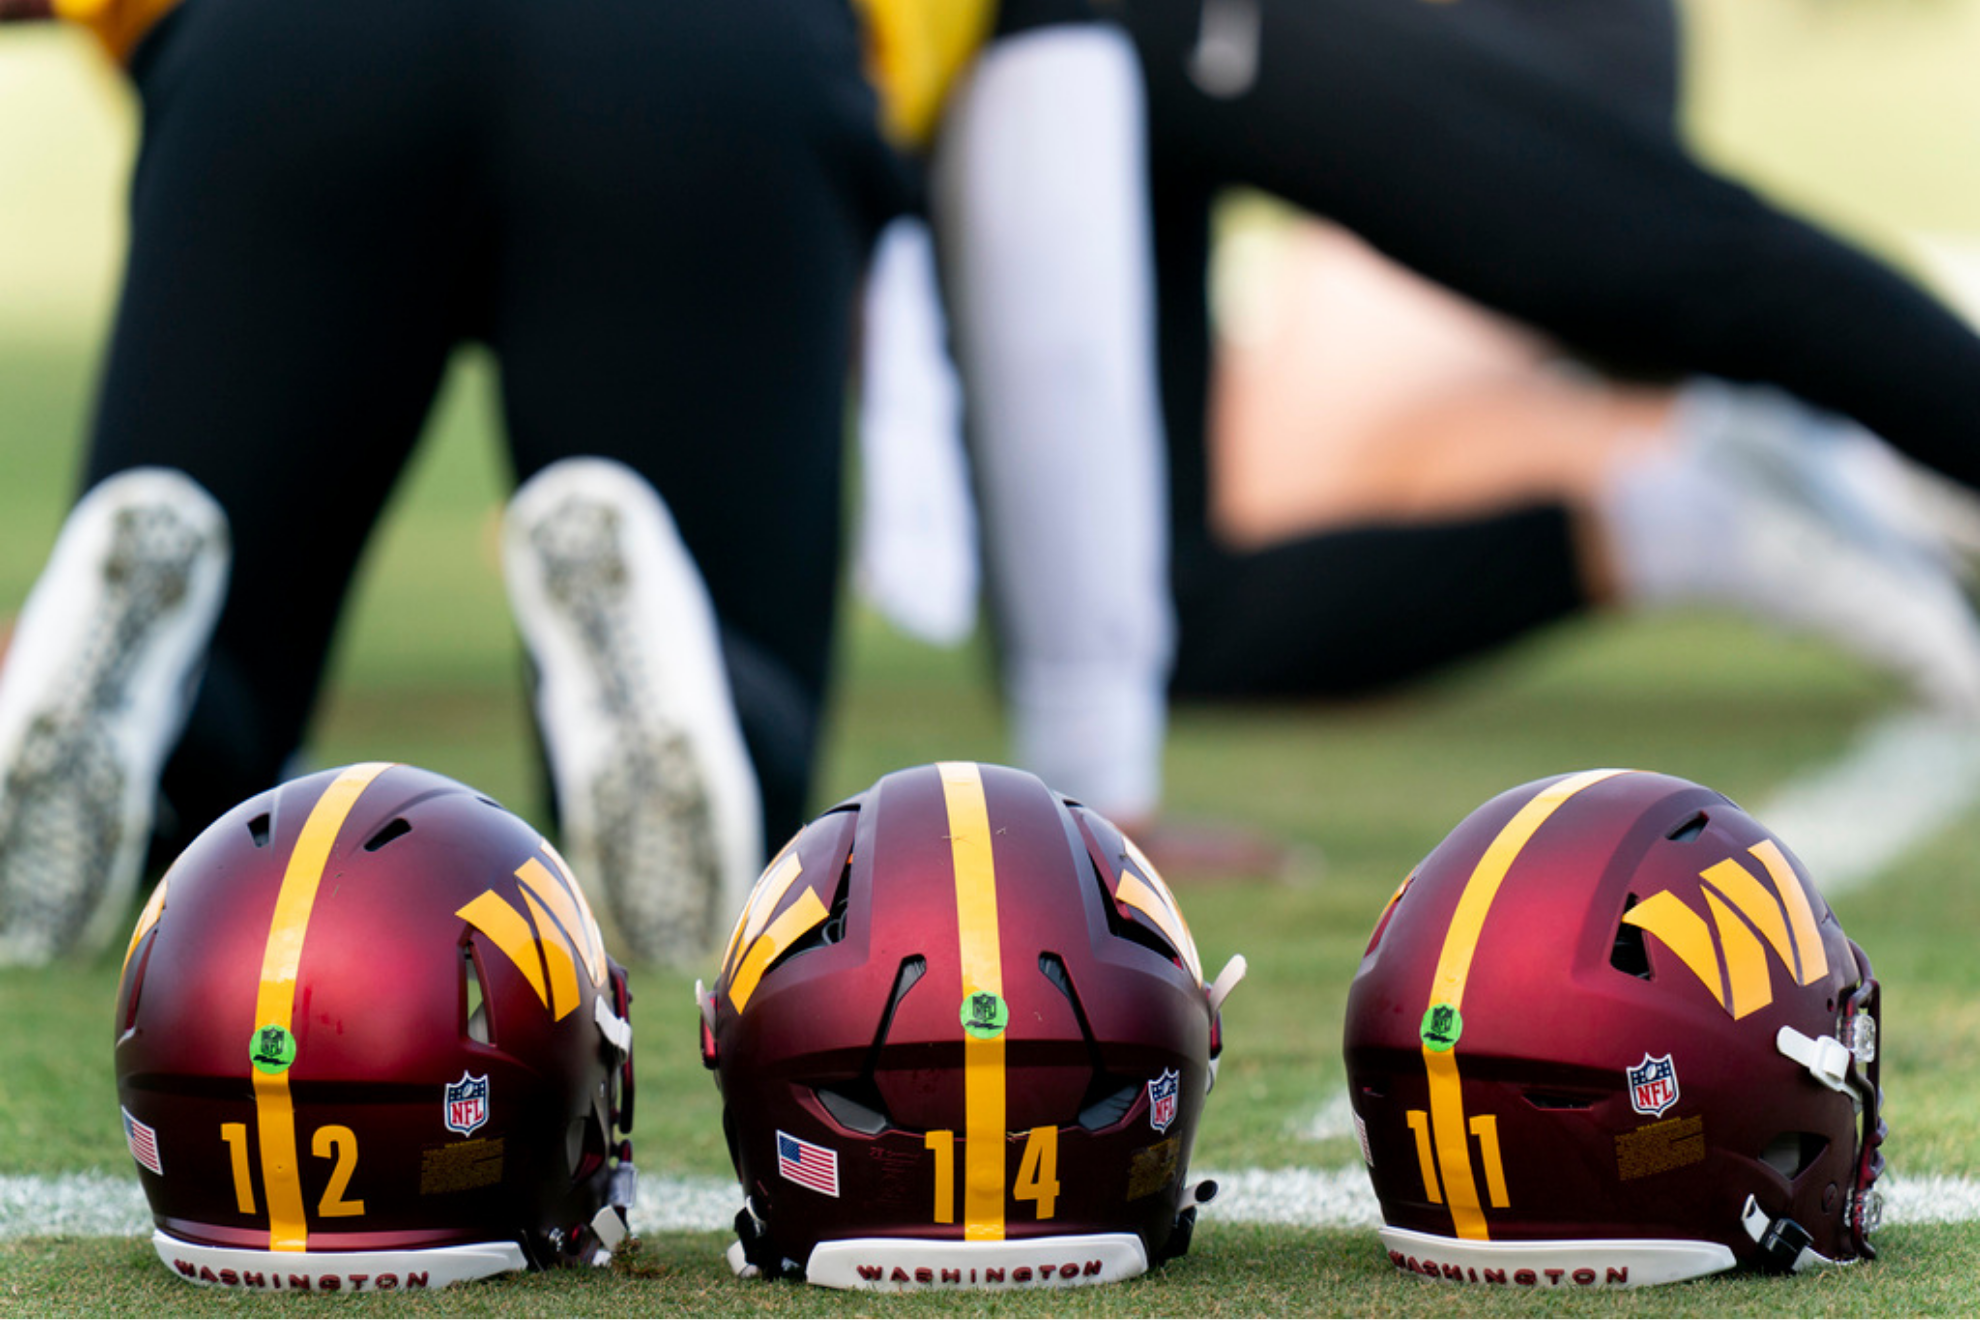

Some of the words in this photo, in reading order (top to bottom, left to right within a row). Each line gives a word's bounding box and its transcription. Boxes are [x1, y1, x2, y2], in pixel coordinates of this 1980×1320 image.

[1636, 1079, 1673, 1107] NFL
[451, 1098, 484, 1126] NFL
[1155, 1095, 1174, 1123] NFL
[173, 1258, 429, 1291] WASHINGTON
[856, 1259, 1103, 1284] WASHINGTON
[1388, 1250, 1629, 1286] WASHINGTON
